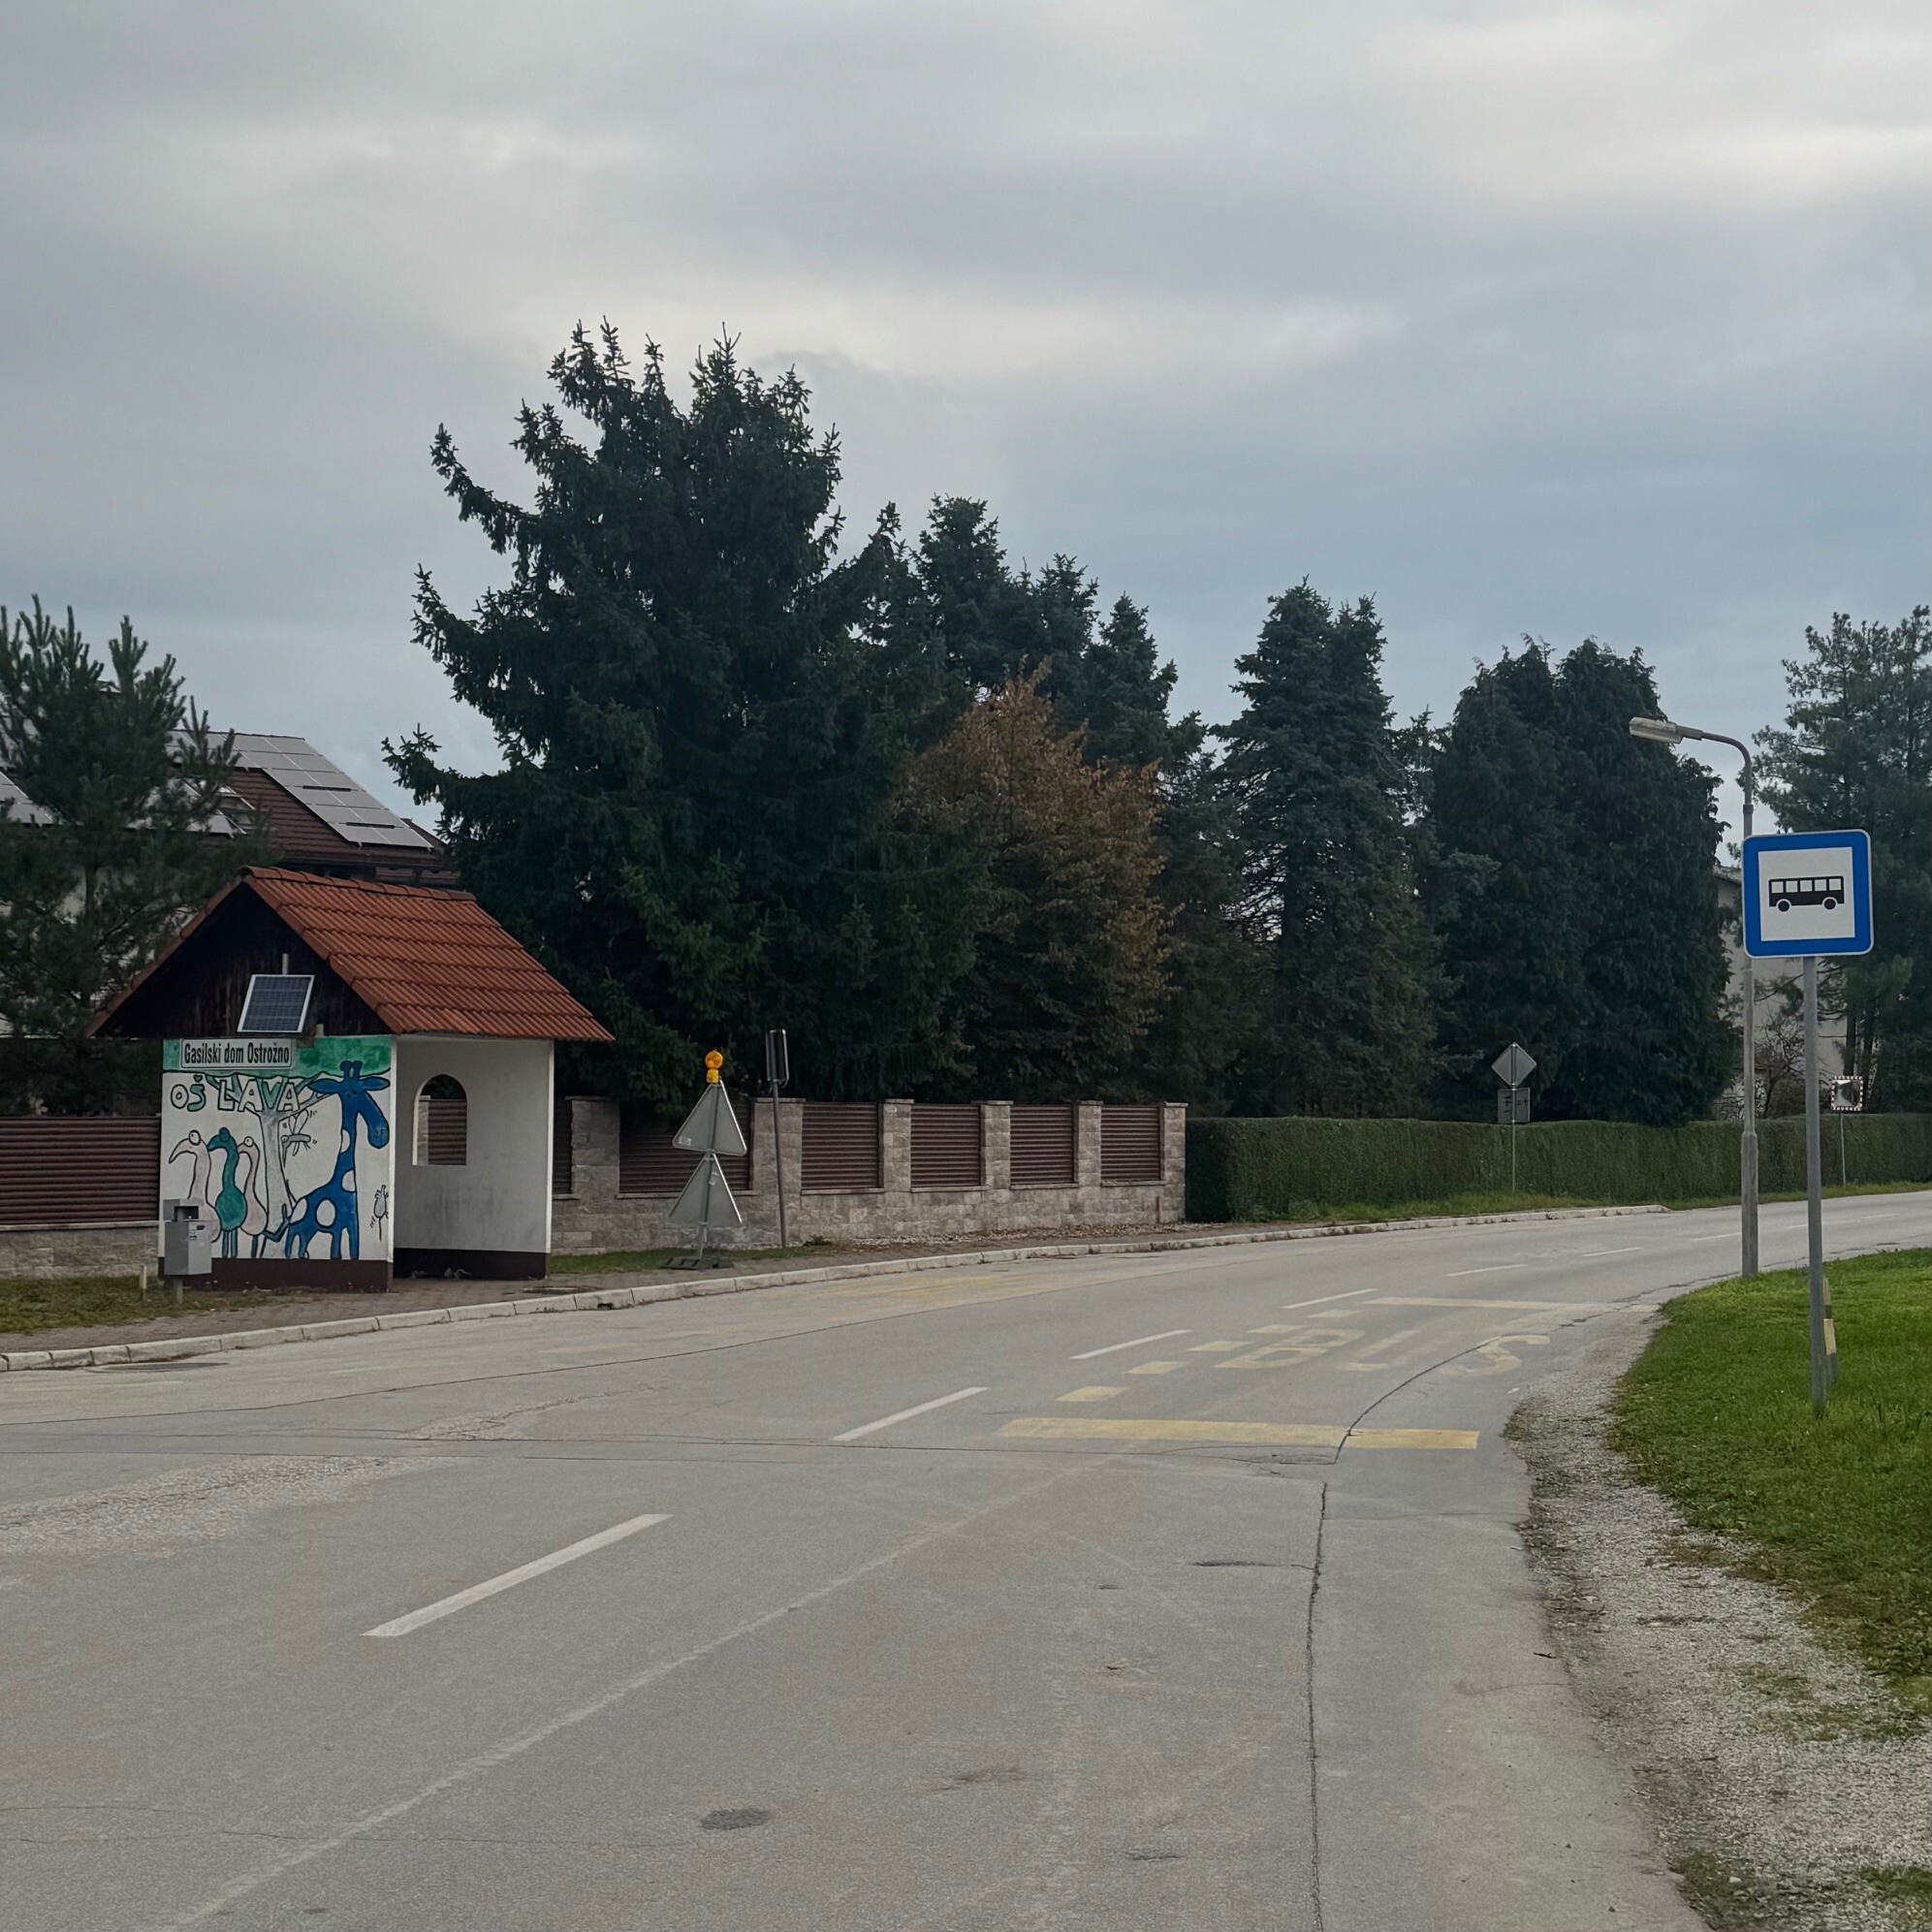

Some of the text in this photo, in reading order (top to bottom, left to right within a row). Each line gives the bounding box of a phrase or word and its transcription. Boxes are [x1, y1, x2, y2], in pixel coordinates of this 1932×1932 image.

[184, 1042, 290, 1063] Gasilski dom Ostrožno
[217, 1079, 301, 1112] LAVA
[1214, 1327, 1552, 1377] BUS
